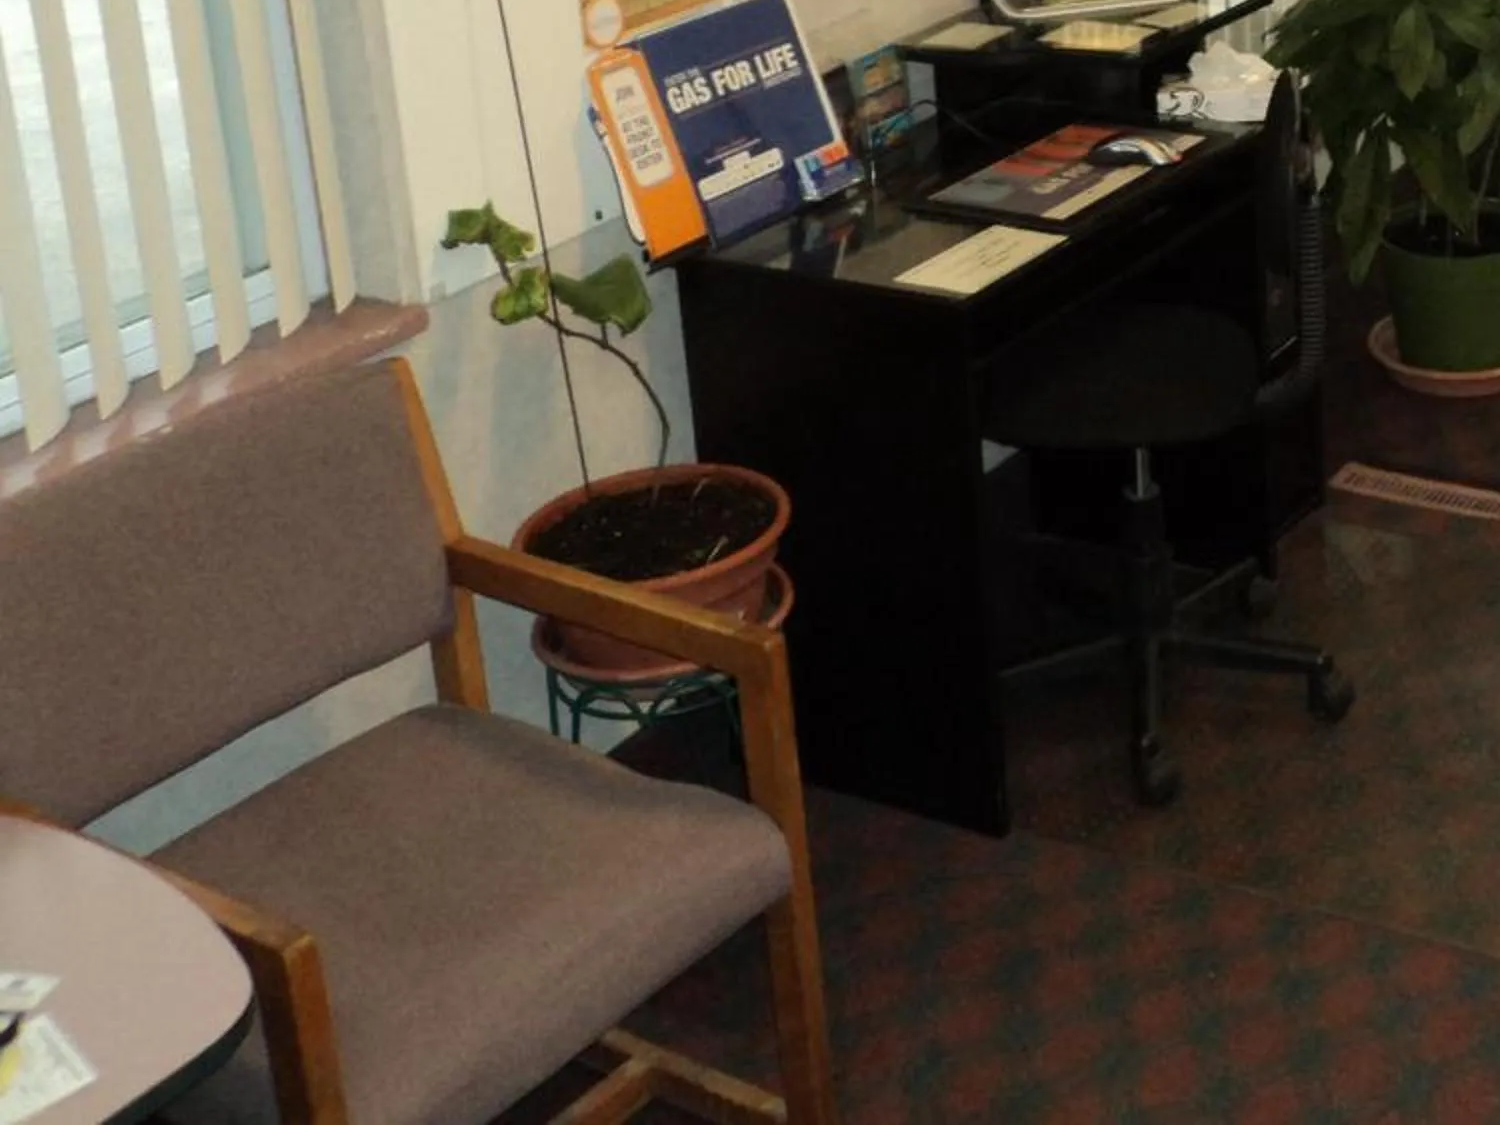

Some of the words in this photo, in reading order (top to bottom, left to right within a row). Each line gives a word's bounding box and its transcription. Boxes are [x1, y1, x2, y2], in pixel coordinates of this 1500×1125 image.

[666, 77, 712, 114] GAS
[711, 60, 756, 96] FOR
[753, 43, 799, 78] LIFE
